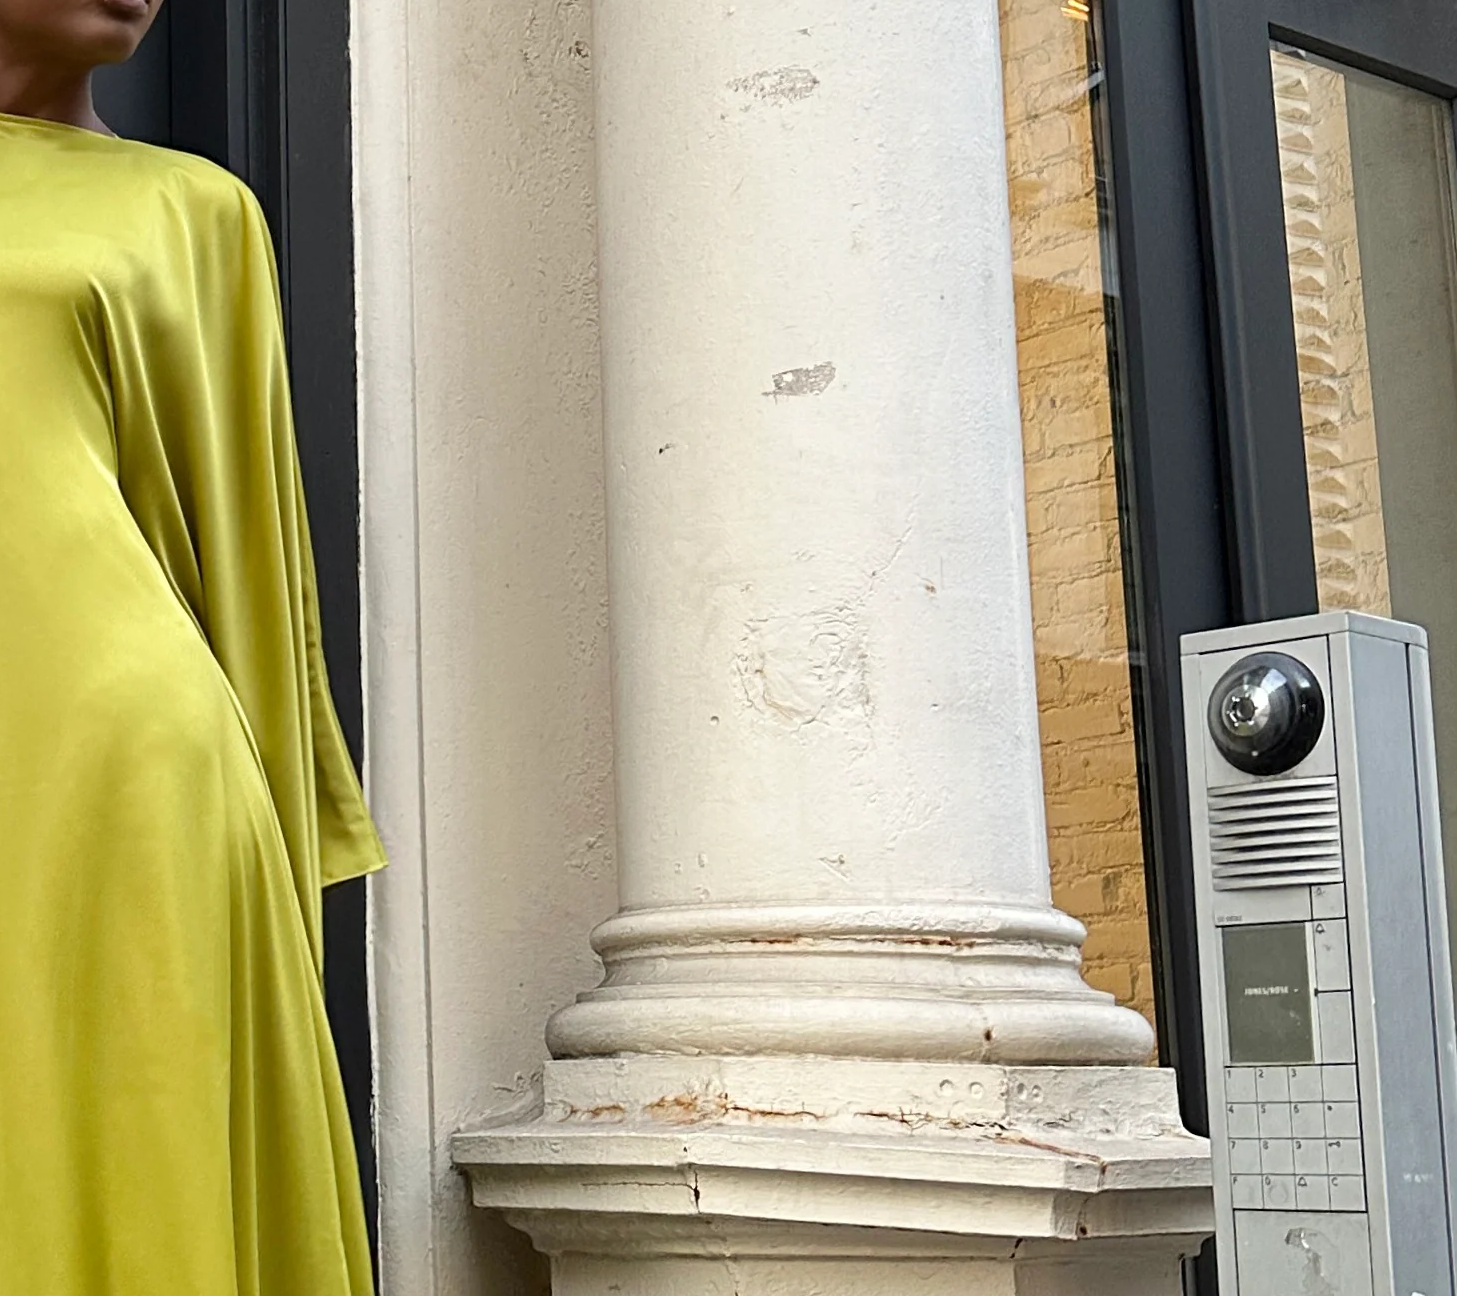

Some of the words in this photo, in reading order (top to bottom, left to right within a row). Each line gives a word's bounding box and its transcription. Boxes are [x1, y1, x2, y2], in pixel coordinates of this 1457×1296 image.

[1258, 1069, 1264, 1078] 2
[1291, 1068, 1297, 1078] 3
[1293, 1104, 1300, 1114] 6
[1262, 1140, 1269, 1150] 8
[1331, 1176, 1338, 1187] C
